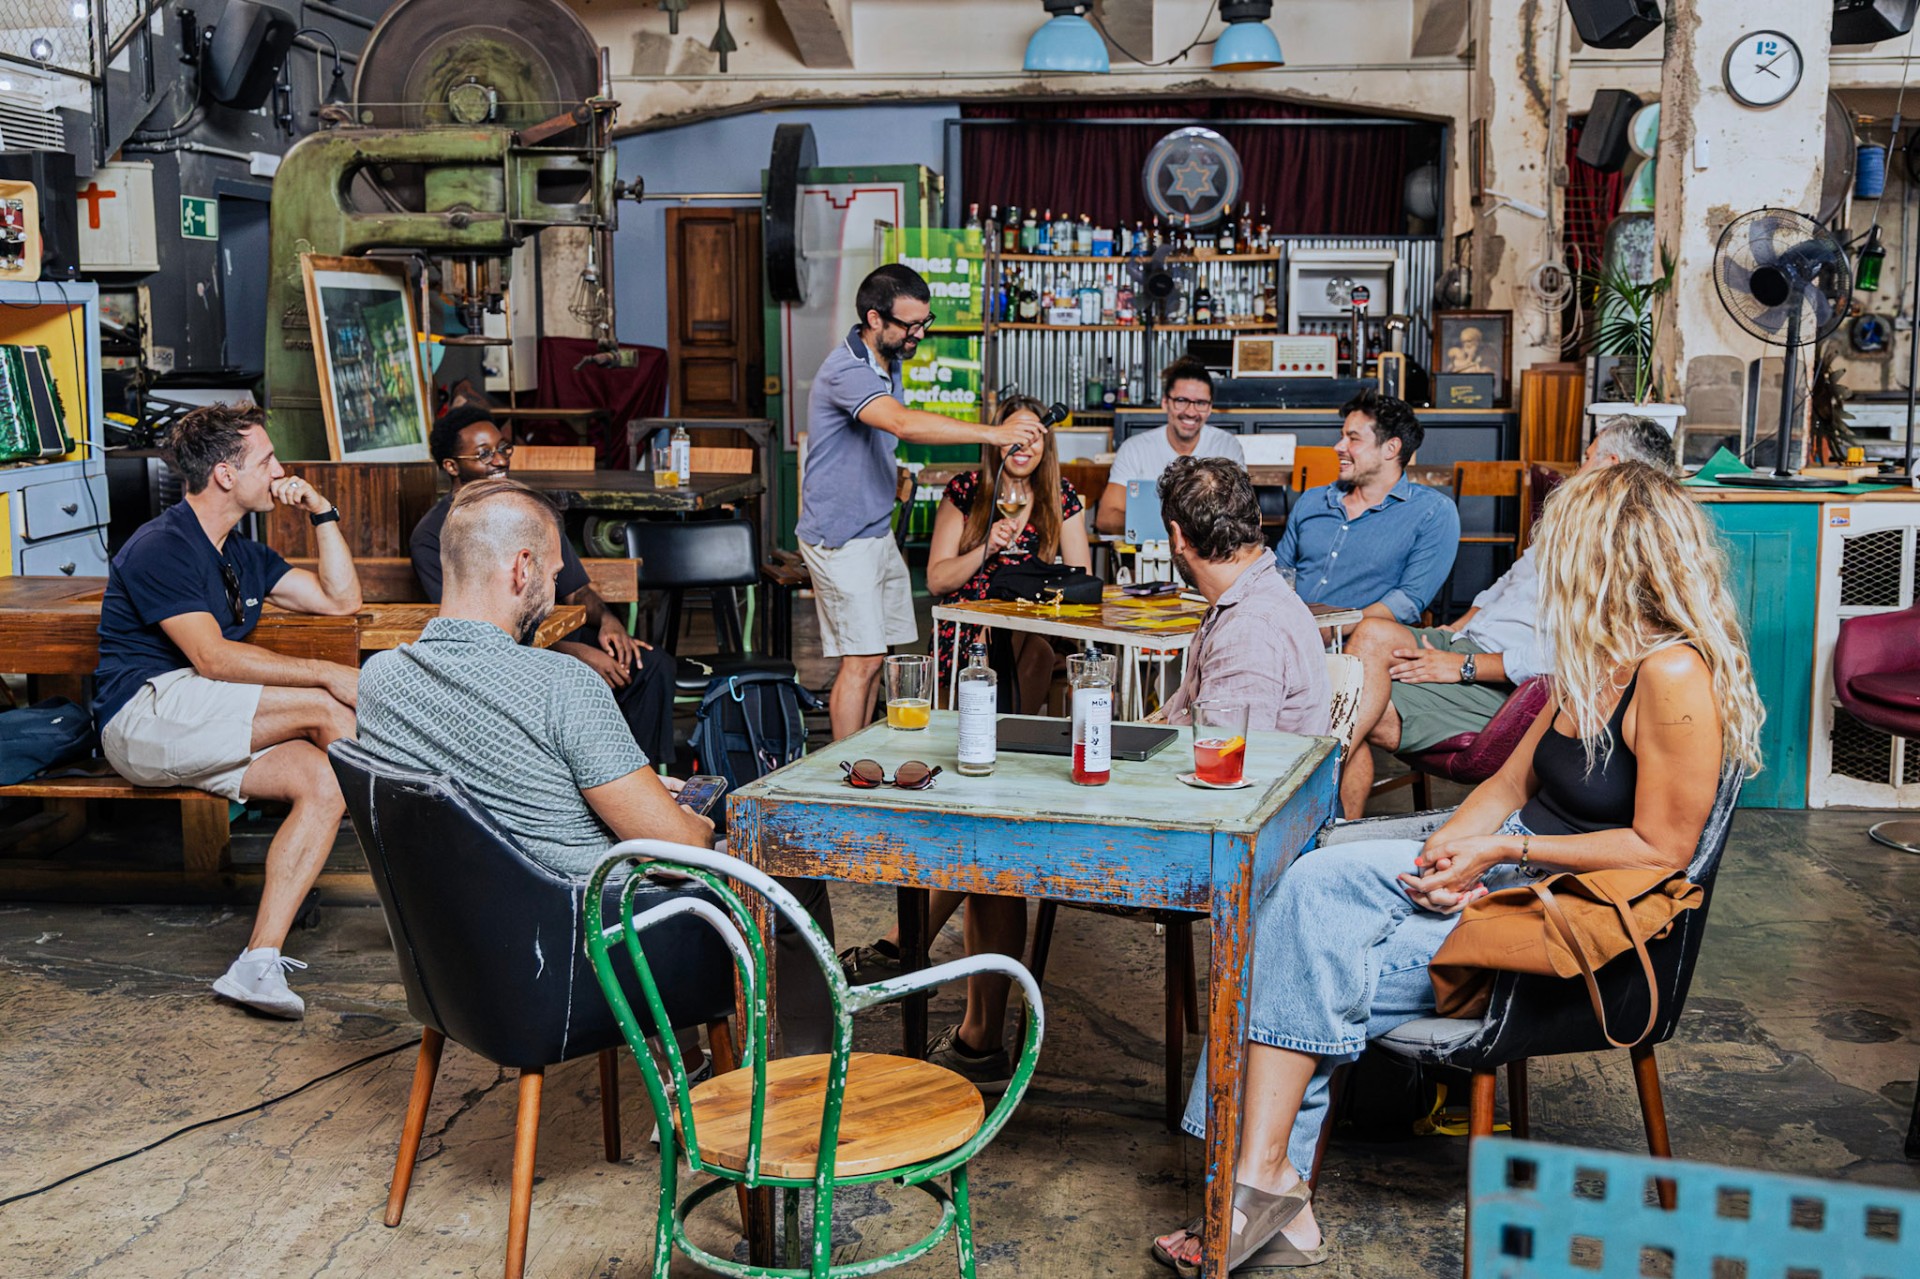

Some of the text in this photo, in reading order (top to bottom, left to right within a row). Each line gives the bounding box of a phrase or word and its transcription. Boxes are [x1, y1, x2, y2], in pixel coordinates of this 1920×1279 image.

[1756, 41, 1778, 56] 12
[909, 361, 952, 383] cafe
[903, 385, 976, 406] perfecto
